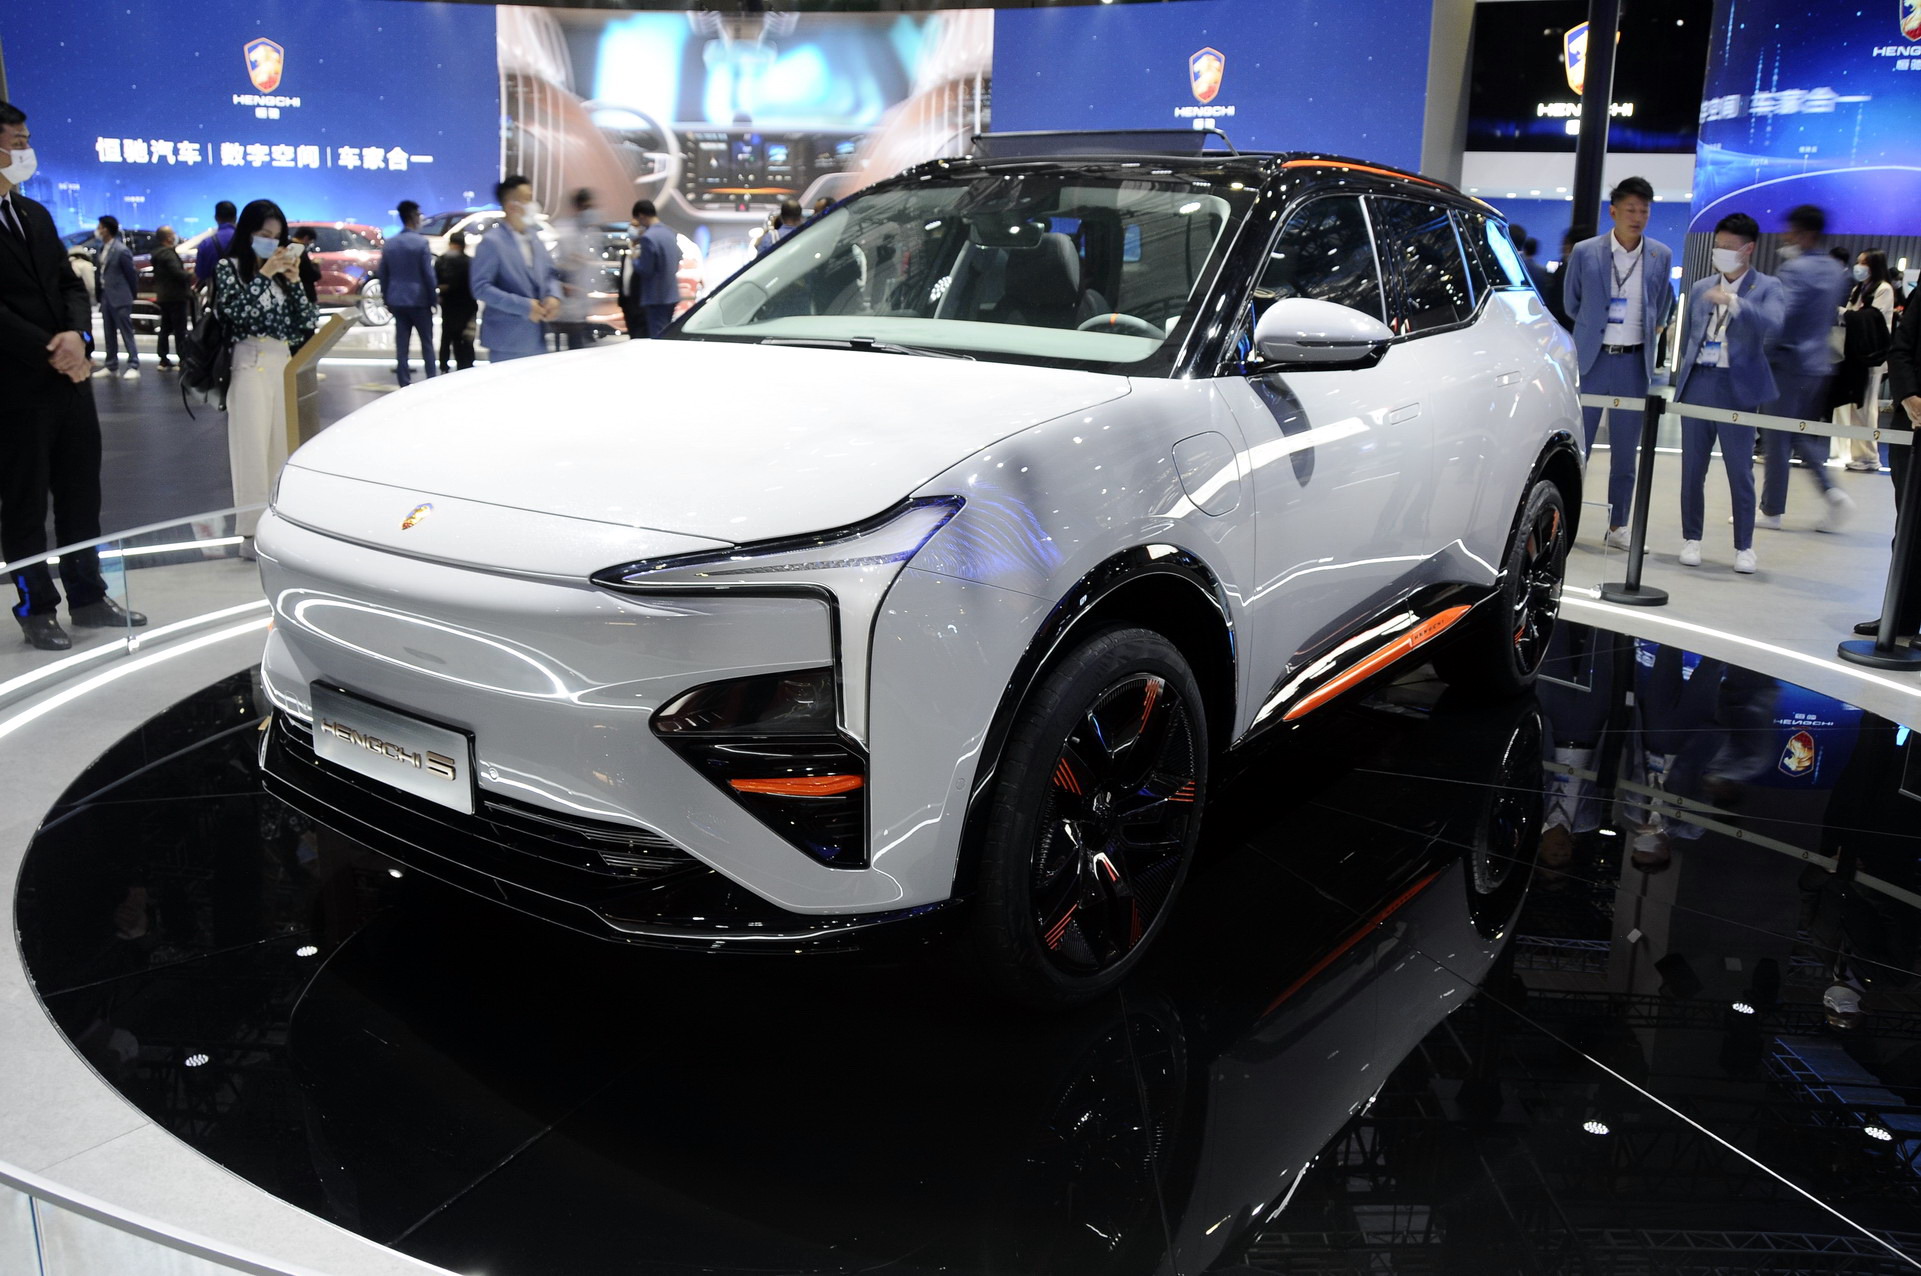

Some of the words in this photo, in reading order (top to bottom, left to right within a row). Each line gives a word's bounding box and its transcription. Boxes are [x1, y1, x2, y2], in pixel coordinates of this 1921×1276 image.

[1872, 46, 1921, 57] HENG
[232, 94, 301, 108] HENGCHI
[1174, 105, 1235, 118] HENGCHI
[1537, 103, 1634, 117] HENHI
[95, 136, 202, 166] 恒驰汽车
[220, 141, 320, 169] 数字空间
[337, 146, 434, 170] 车家合一
[320, 718, 422, 769] HENGCHI
